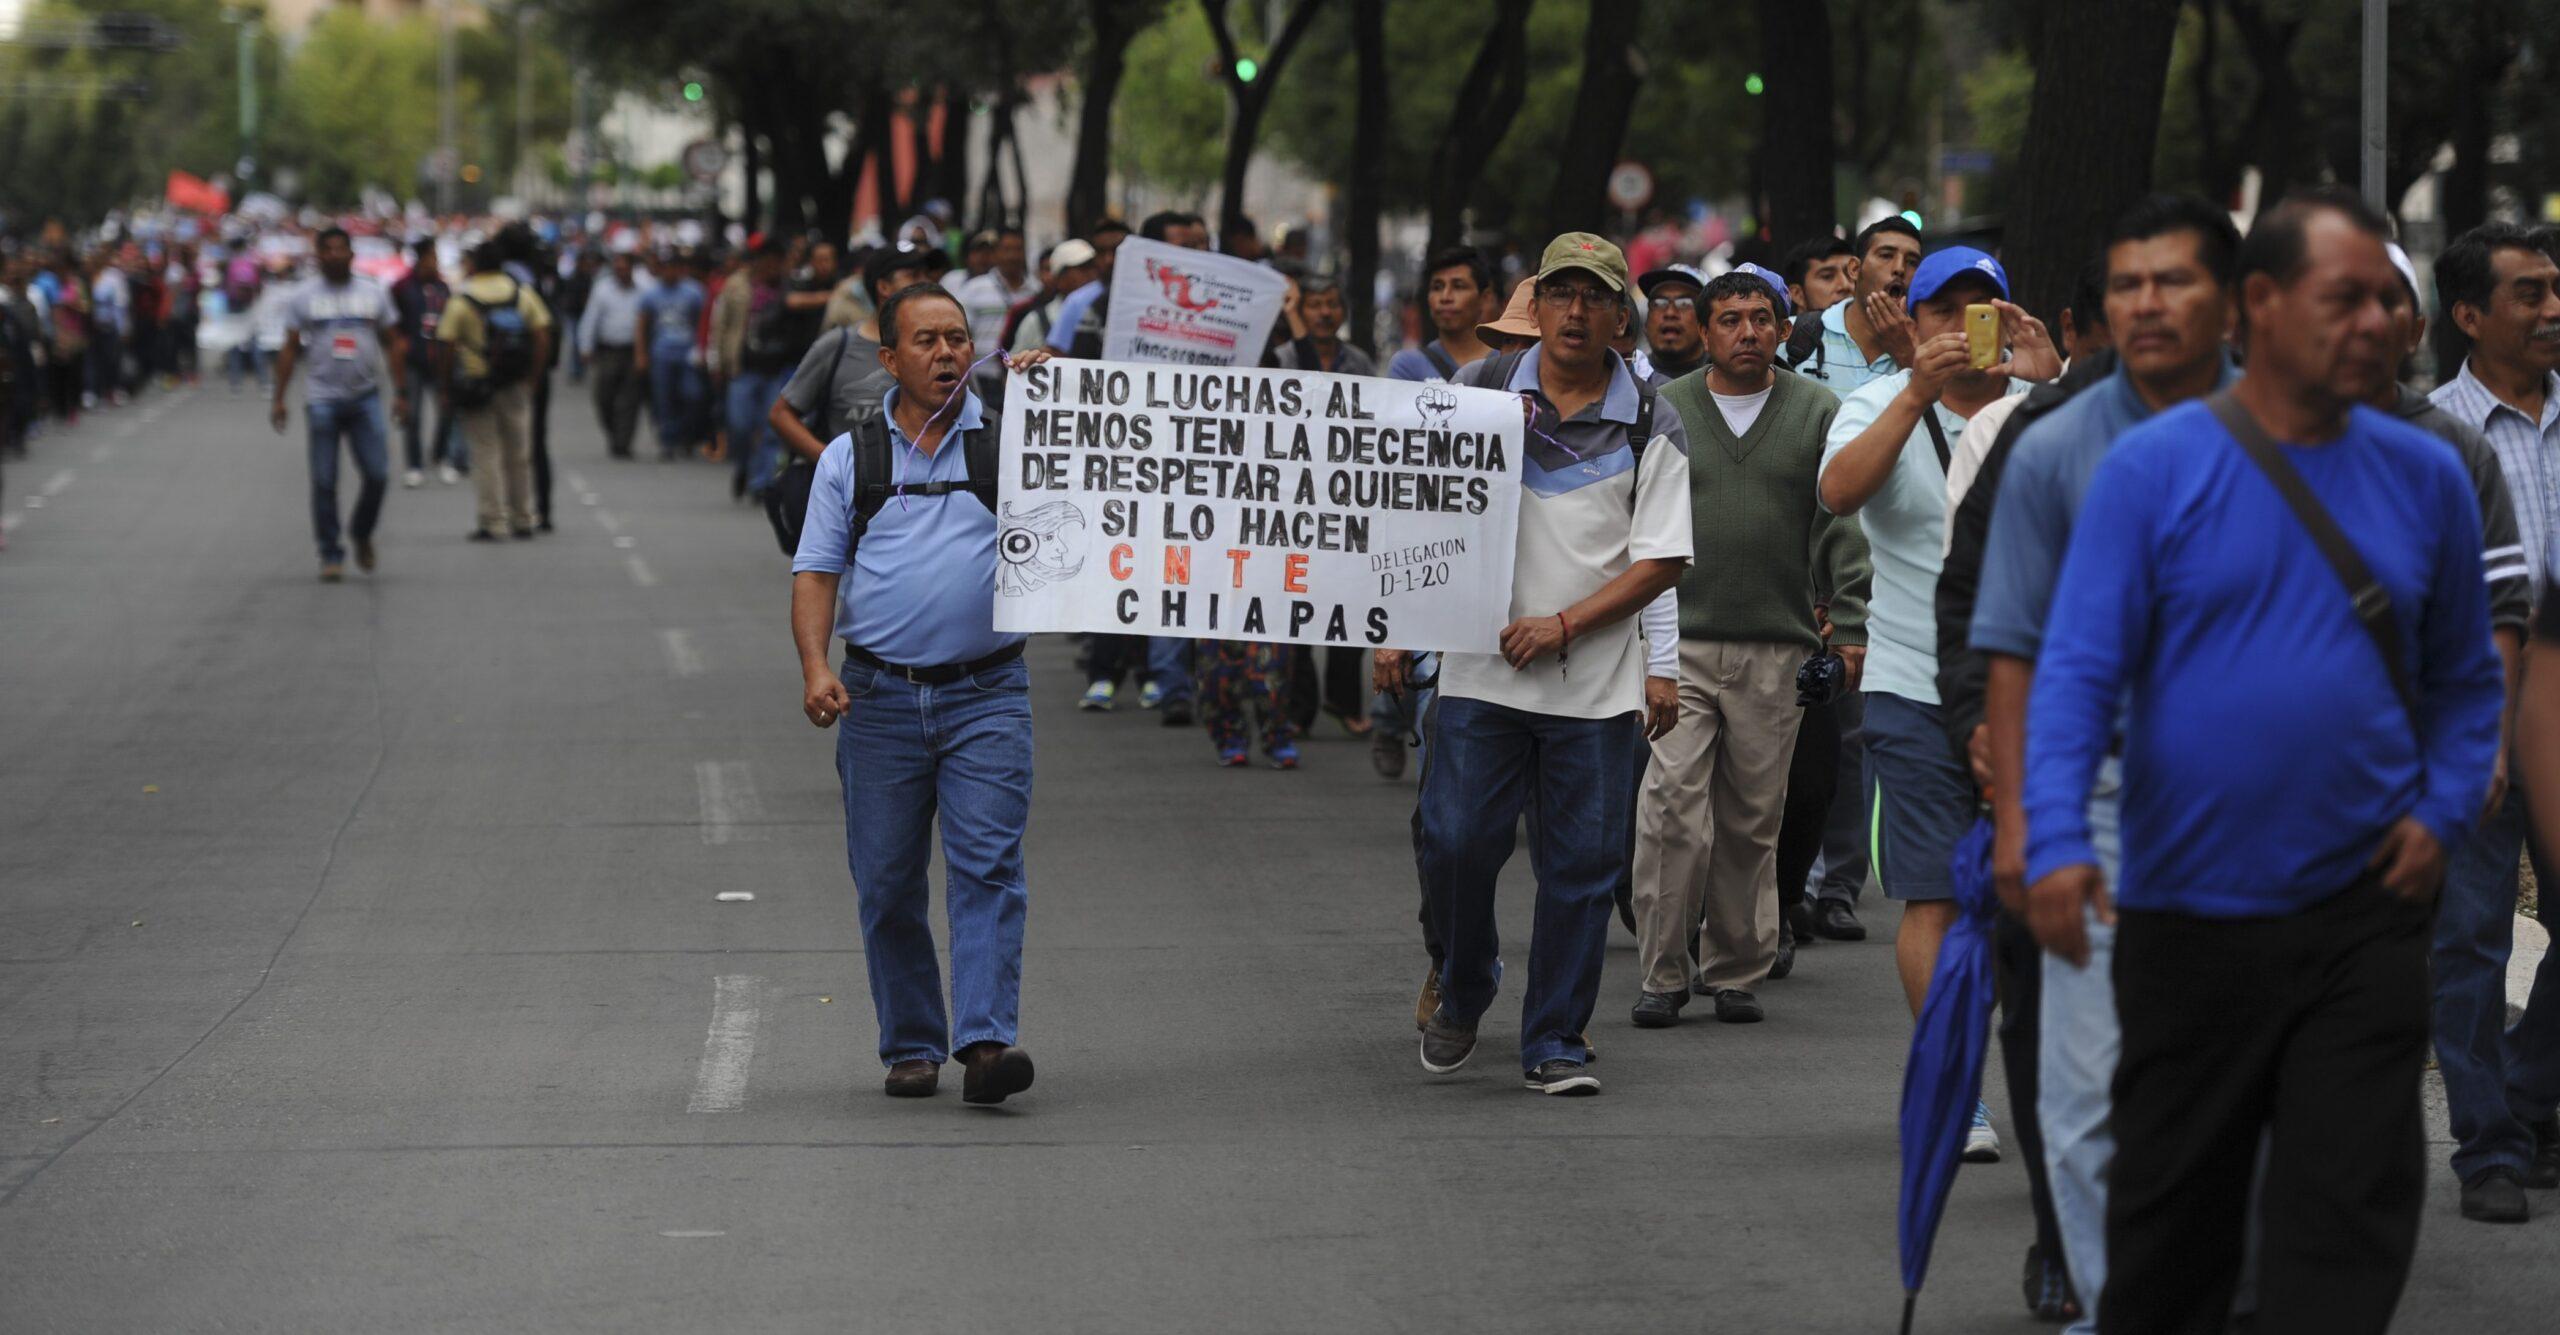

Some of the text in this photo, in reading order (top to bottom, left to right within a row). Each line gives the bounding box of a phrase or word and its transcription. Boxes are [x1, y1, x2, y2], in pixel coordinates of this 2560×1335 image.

[1026, 365, 1375, 420] SI NO LUCHAS, AL
[1023, 409, 1507, 472] MENOS TEN LA DECENCIA
[1021, 452, 1489, 515] DE RESPETAR A QUIENES
[1101, 500, 1370, 553] SI LO HACEN
[1371, 537, 1465, 572] DELEGACION
[1381, 562, 1449, 597] D-1-20
[1116, 588, 1389, 644] CHIAPAS
